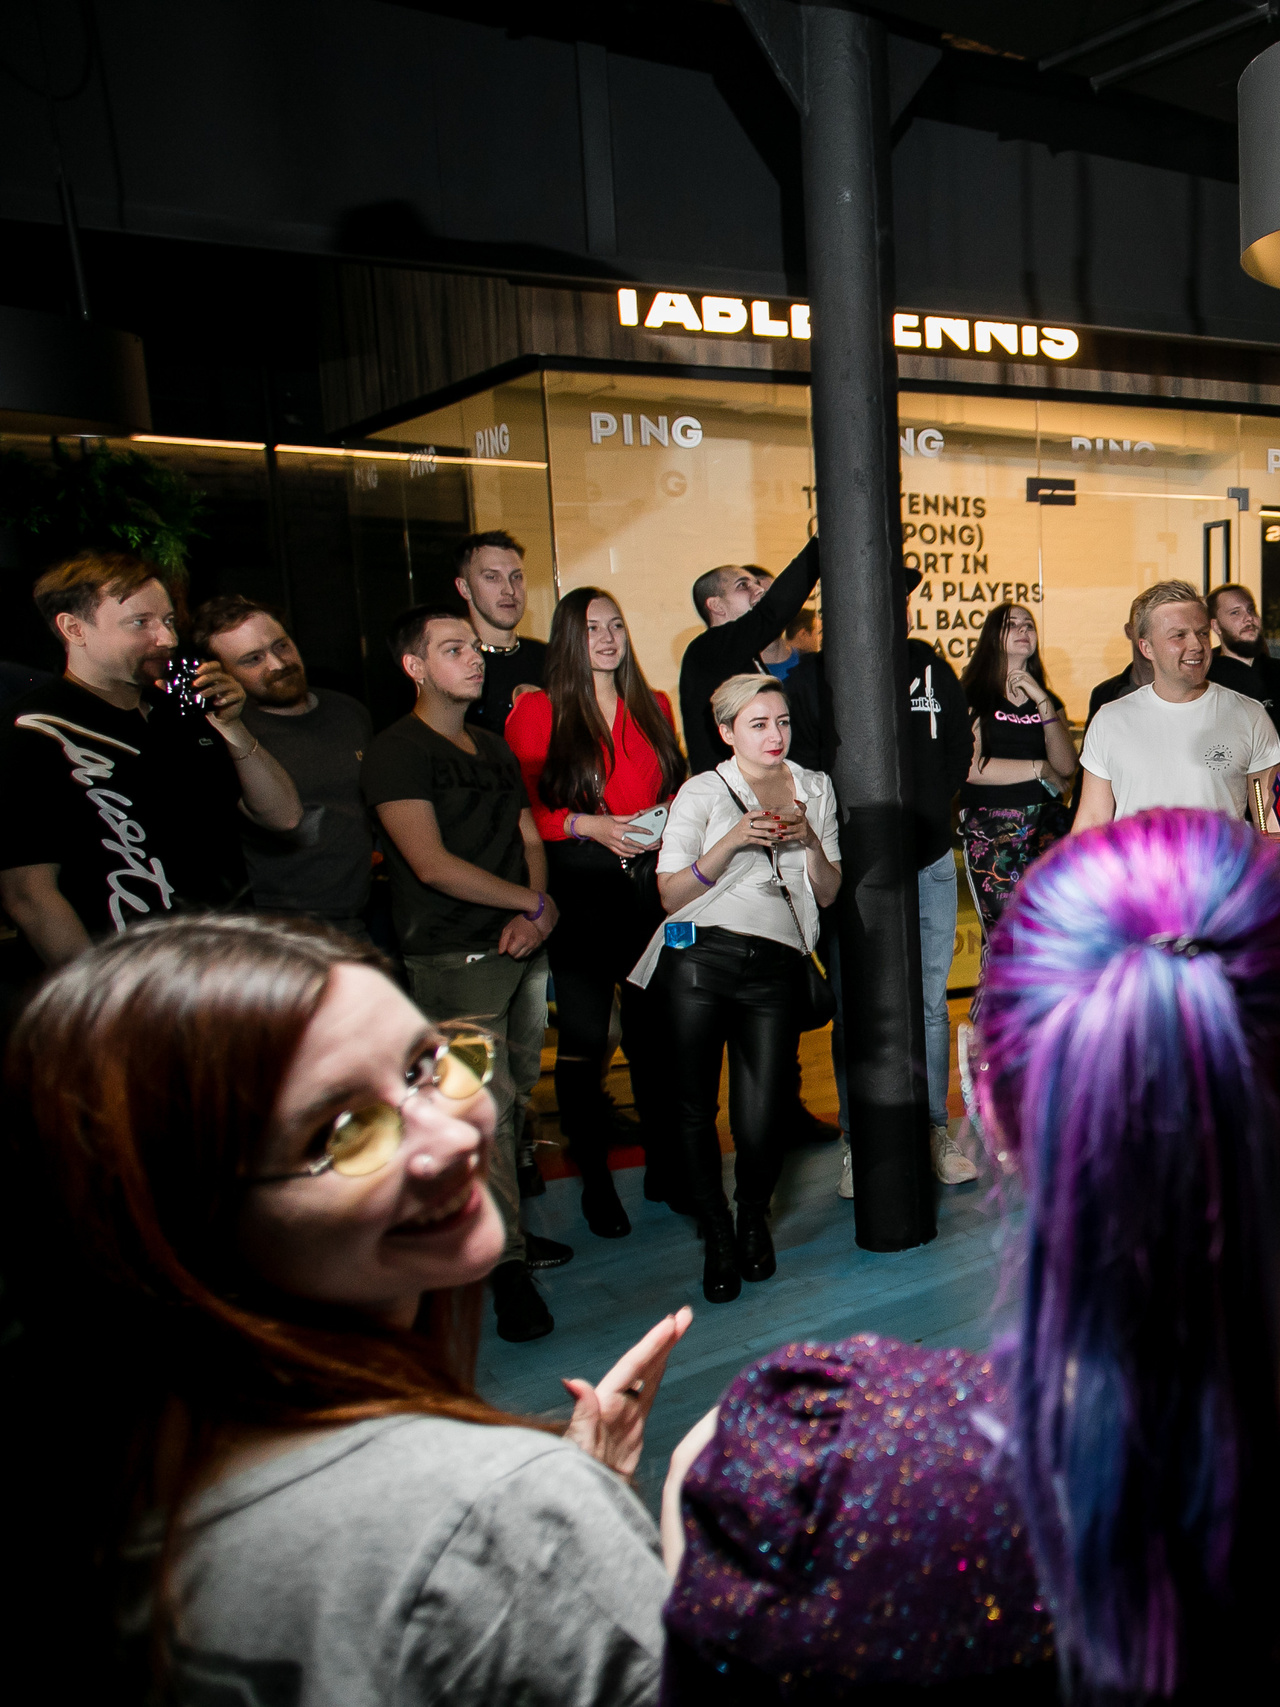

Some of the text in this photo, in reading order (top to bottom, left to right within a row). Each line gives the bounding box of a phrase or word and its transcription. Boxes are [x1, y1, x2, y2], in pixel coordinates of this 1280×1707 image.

[893, 313, 1080, 361] ENNIS
[474, 422, 510, 459] PING
[590, 411, 703, 449] PING
[899, 427, 945, 458] NG
[902, 492, 986, 519] ENNIS
[904, 552, 989, 575] ORT IN
[919, 580, 1045, 603] 4 PLAYERS
[936, 609, 990, 631] BAC
[994, 710, 1042, 725] adida
